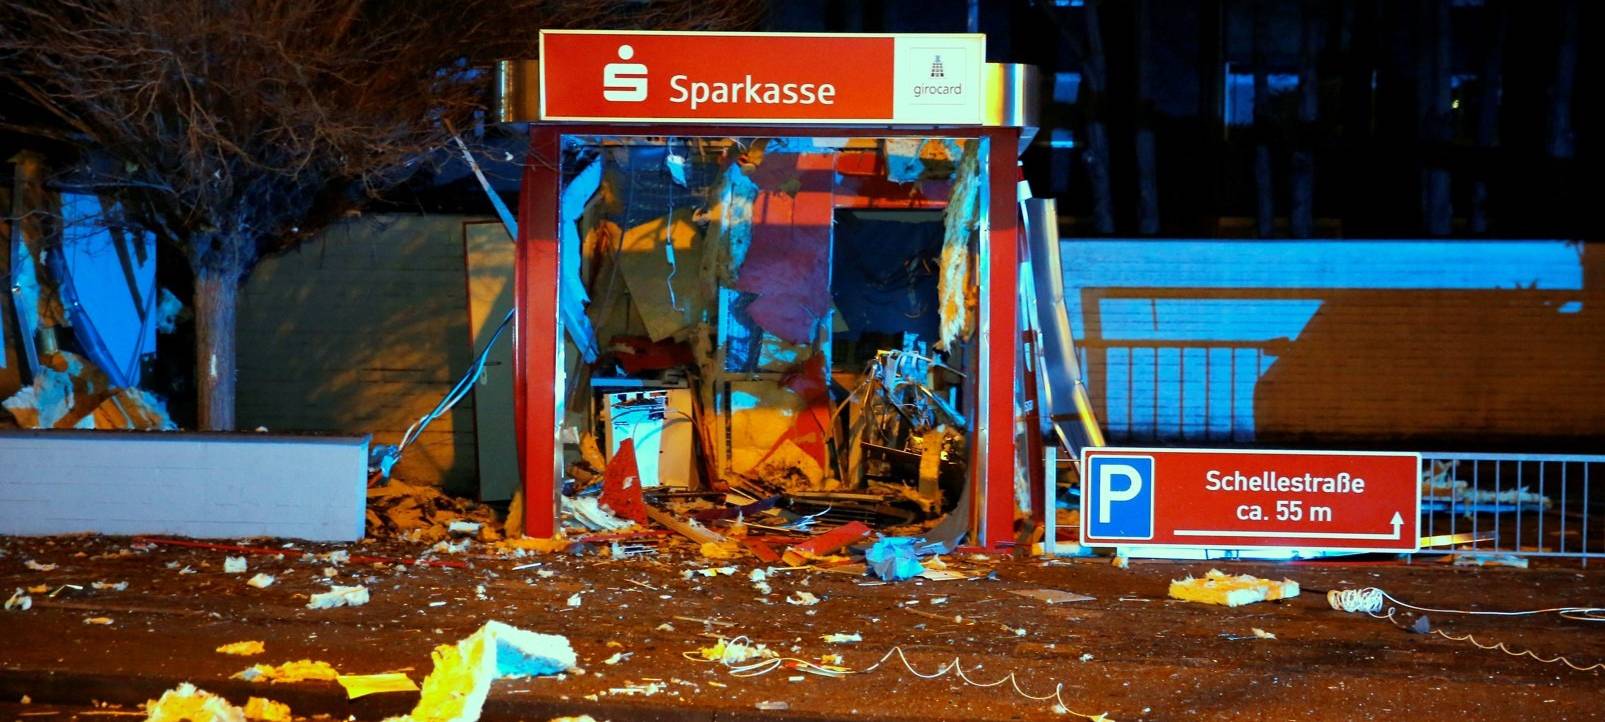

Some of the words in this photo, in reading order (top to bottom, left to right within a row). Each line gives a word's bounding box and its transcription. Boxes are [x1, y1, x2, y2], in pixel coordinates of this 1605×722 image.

[669, 75, 836, 110] Sparkasse
[913, 81, 962, 98] girocard
[1099, 464, 1143, 524] P
[1205, 470, 1365, 494] Schellestraße
[1236, 504, 1269, 521] ca.
[1276, 501, 1303, 522] 55
[1310, 506, 1332, 522] m
